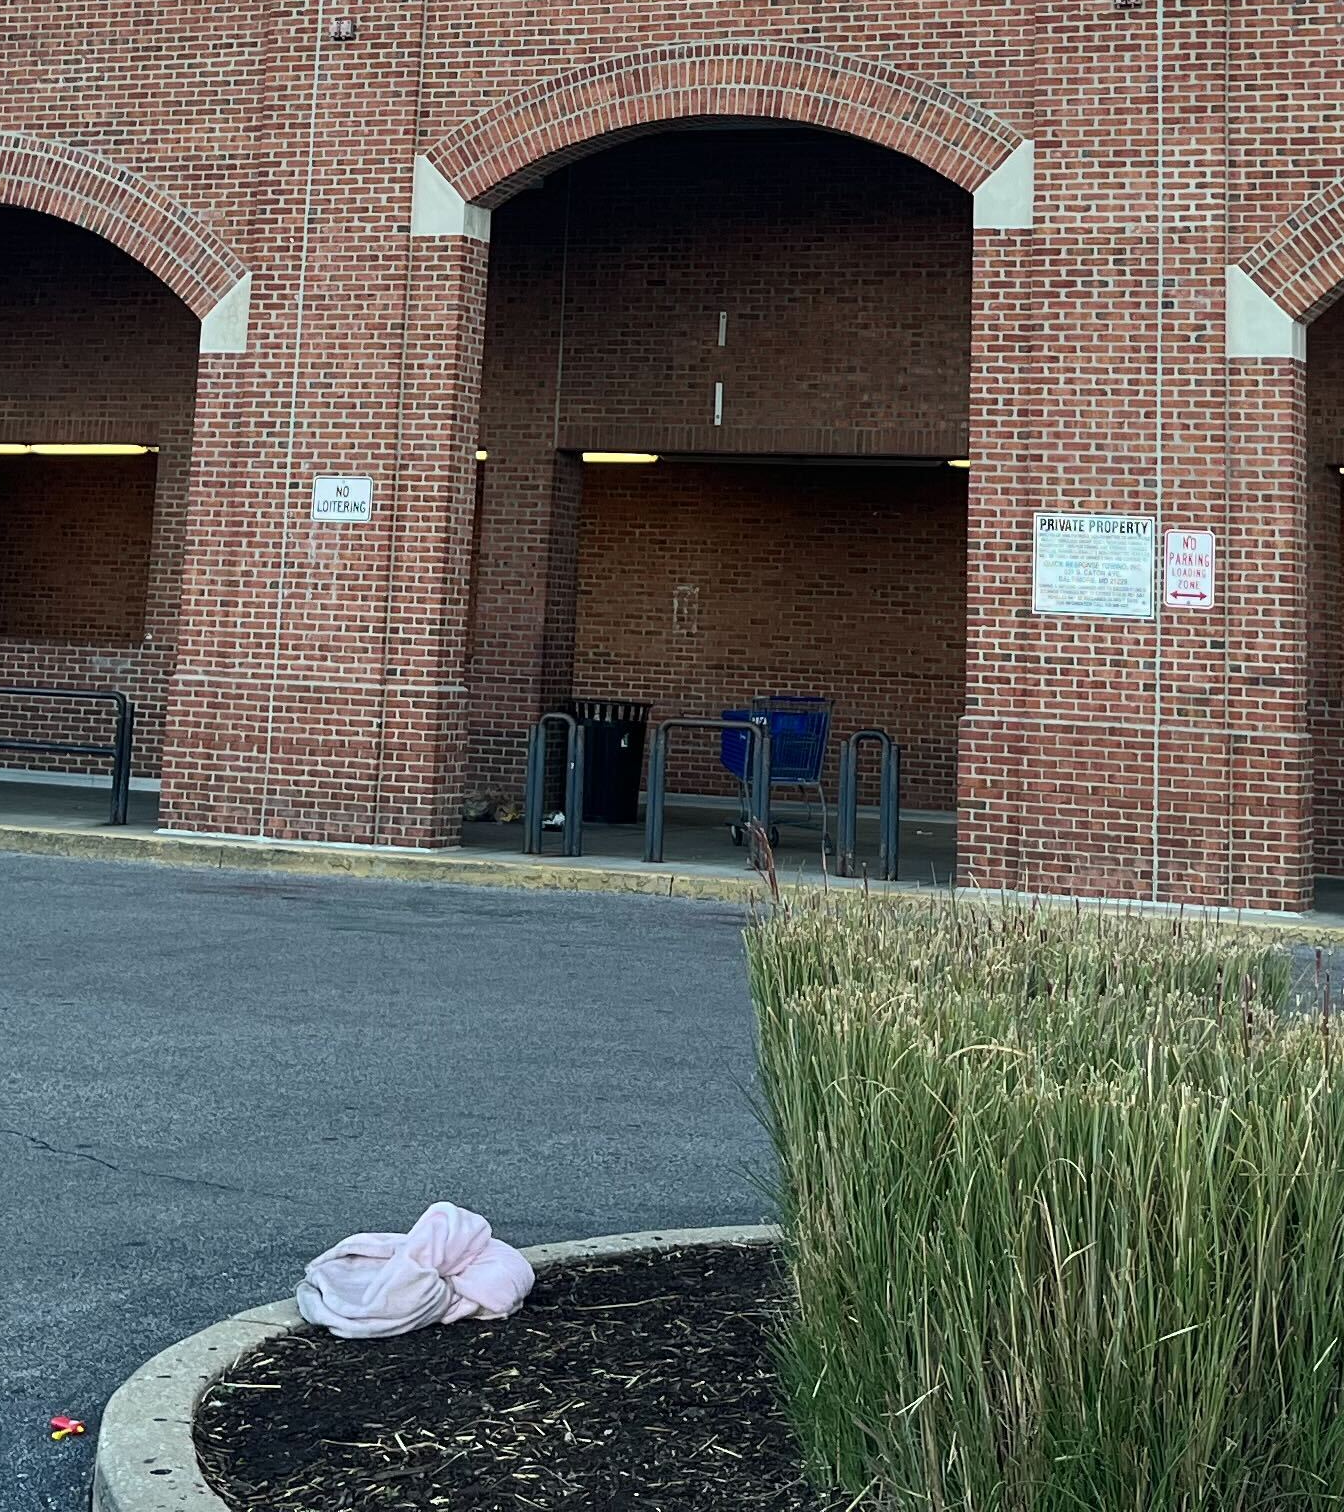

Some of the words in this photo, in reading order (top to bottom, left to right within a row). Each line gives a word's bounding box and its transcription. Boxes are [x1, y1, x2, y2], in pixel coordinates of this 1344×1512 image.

[336, 486, 350, 498] NO
[317, 500, 366, 513] LOITERING
[1040, 518, 1084, 532] PRIVATE
[1089, 520, 1148, 534] PROPERTY
[1182, 536, 1197, 550] NO
[1169, 552, 1210, 567] PARKING
[1171, 567, 1207, 578] LOADING
[1178, 579, 1200, 589] ZONE
